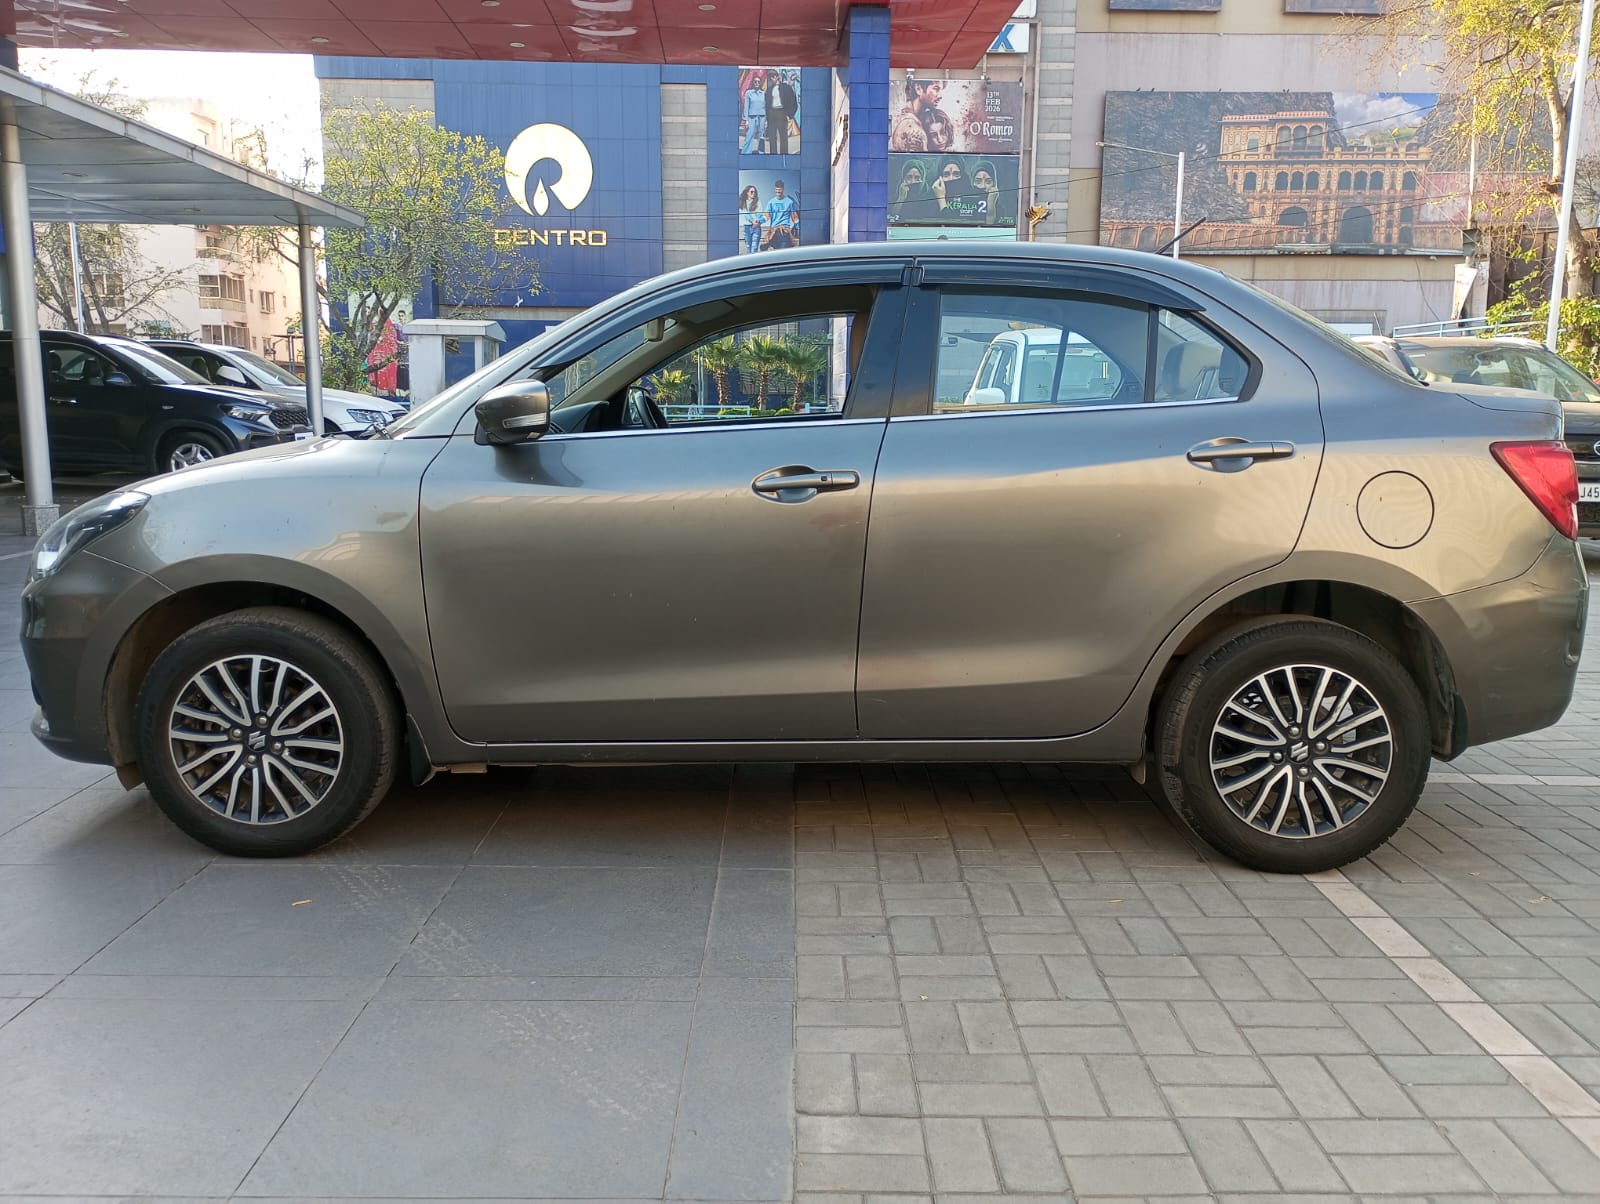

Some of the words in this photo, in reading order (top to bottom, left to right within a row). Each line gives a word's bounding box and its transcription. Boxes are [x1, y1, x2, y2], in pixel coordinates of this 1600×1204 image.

[946, 201, 978, 210] KERALA
[977, 200, 987, 213] 2
[494, 229, 607, 246] CENTRO
